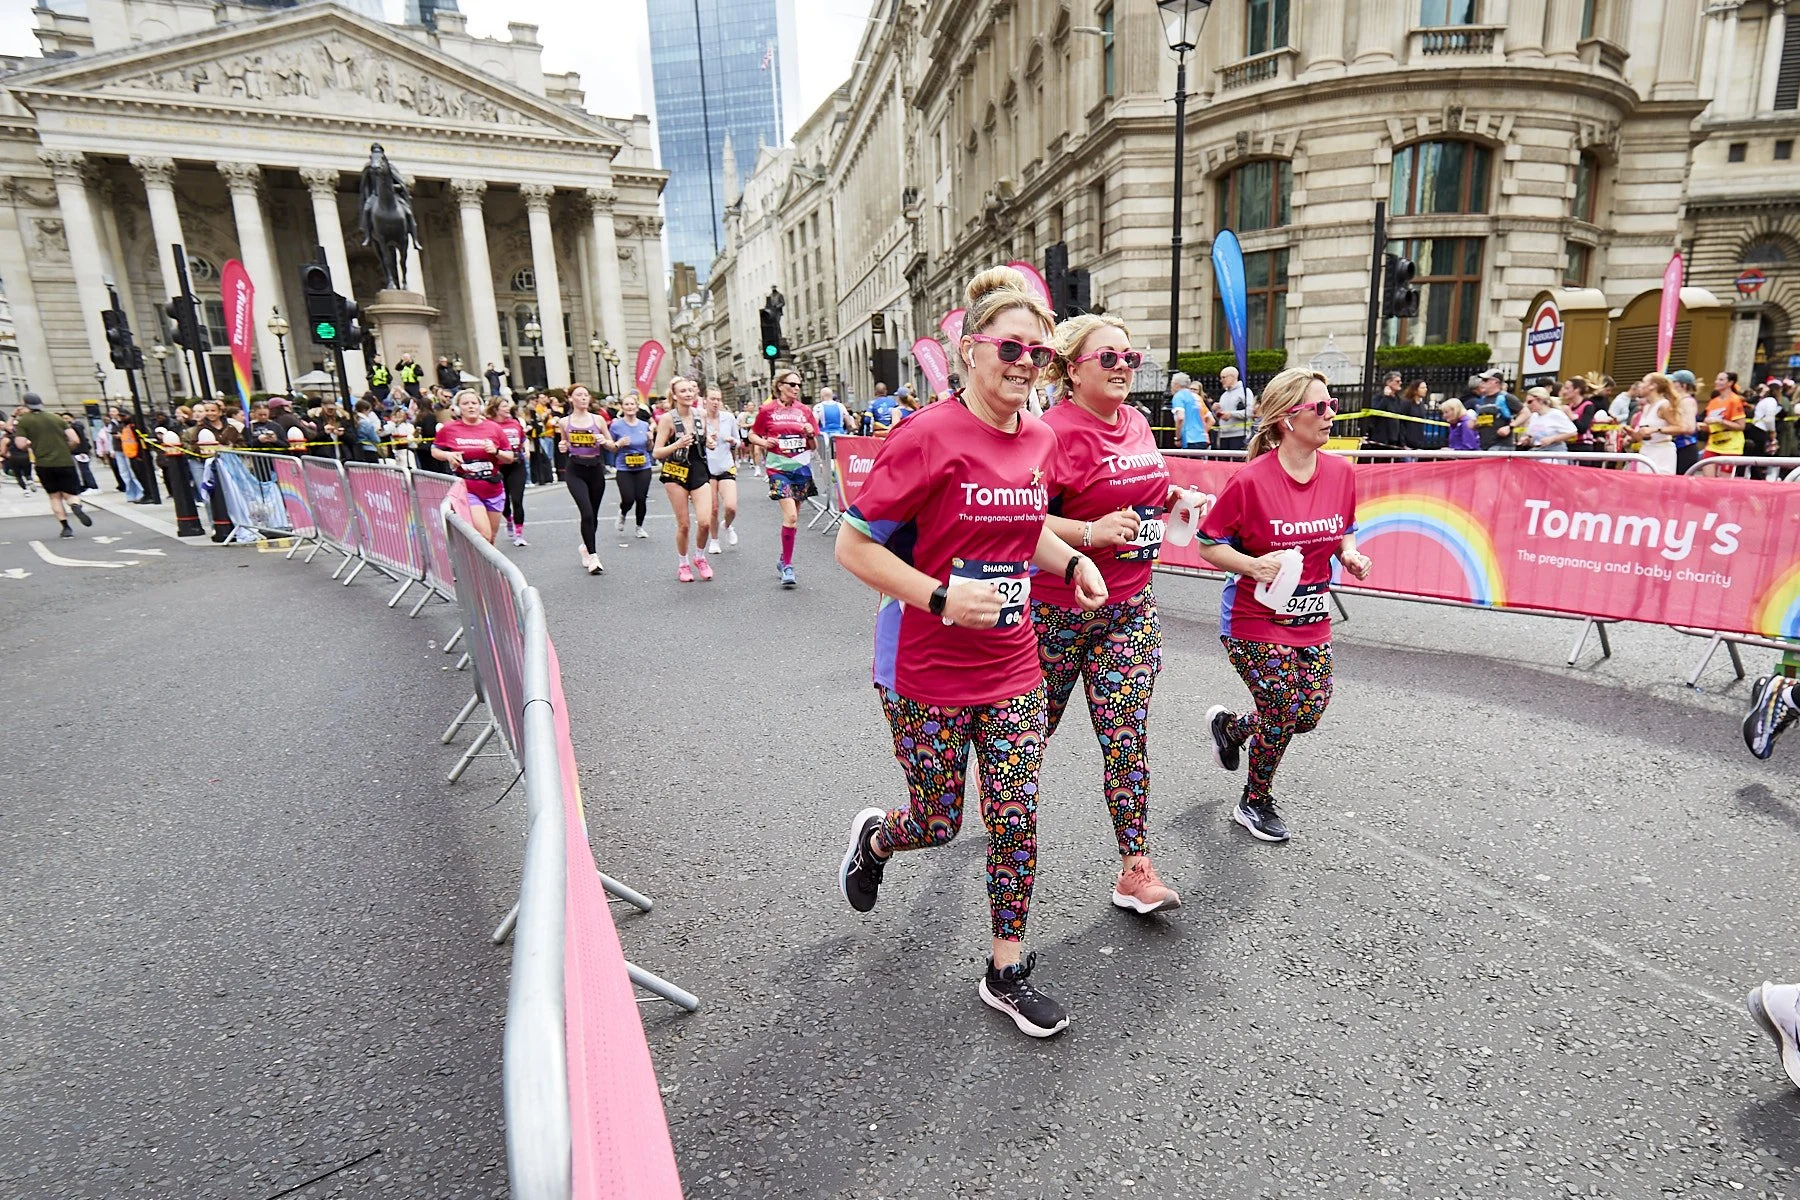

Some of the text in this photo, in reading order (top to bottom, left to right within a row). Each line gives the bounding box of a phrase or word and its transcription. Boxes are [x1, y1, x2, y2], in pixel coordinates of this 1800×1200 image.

[233, 279, 246, 346] Tommy's
[1102, 452, 1165, 473] Tommy
[958, 513, 973, 521] The
[974, 513, 1013, 523] pregnancy
[1013, 513, 1026, 521] and
[1025, 513, 1038, 522] baby
[1269, 513, 1344, 536] Tommy's
[1138, 522, 1161, 542] 480
[1524, 499, 1742, 561] Tommy's
[1282, 539, 1312, 547] pregnancy
[982, 564, 1014, 573] SHARON
[1517, 549, 1732, 589] The pregnancy and baby charity
[990, 581, 1023, 604] 82
[1286, 596, 1324, 613] 9478
